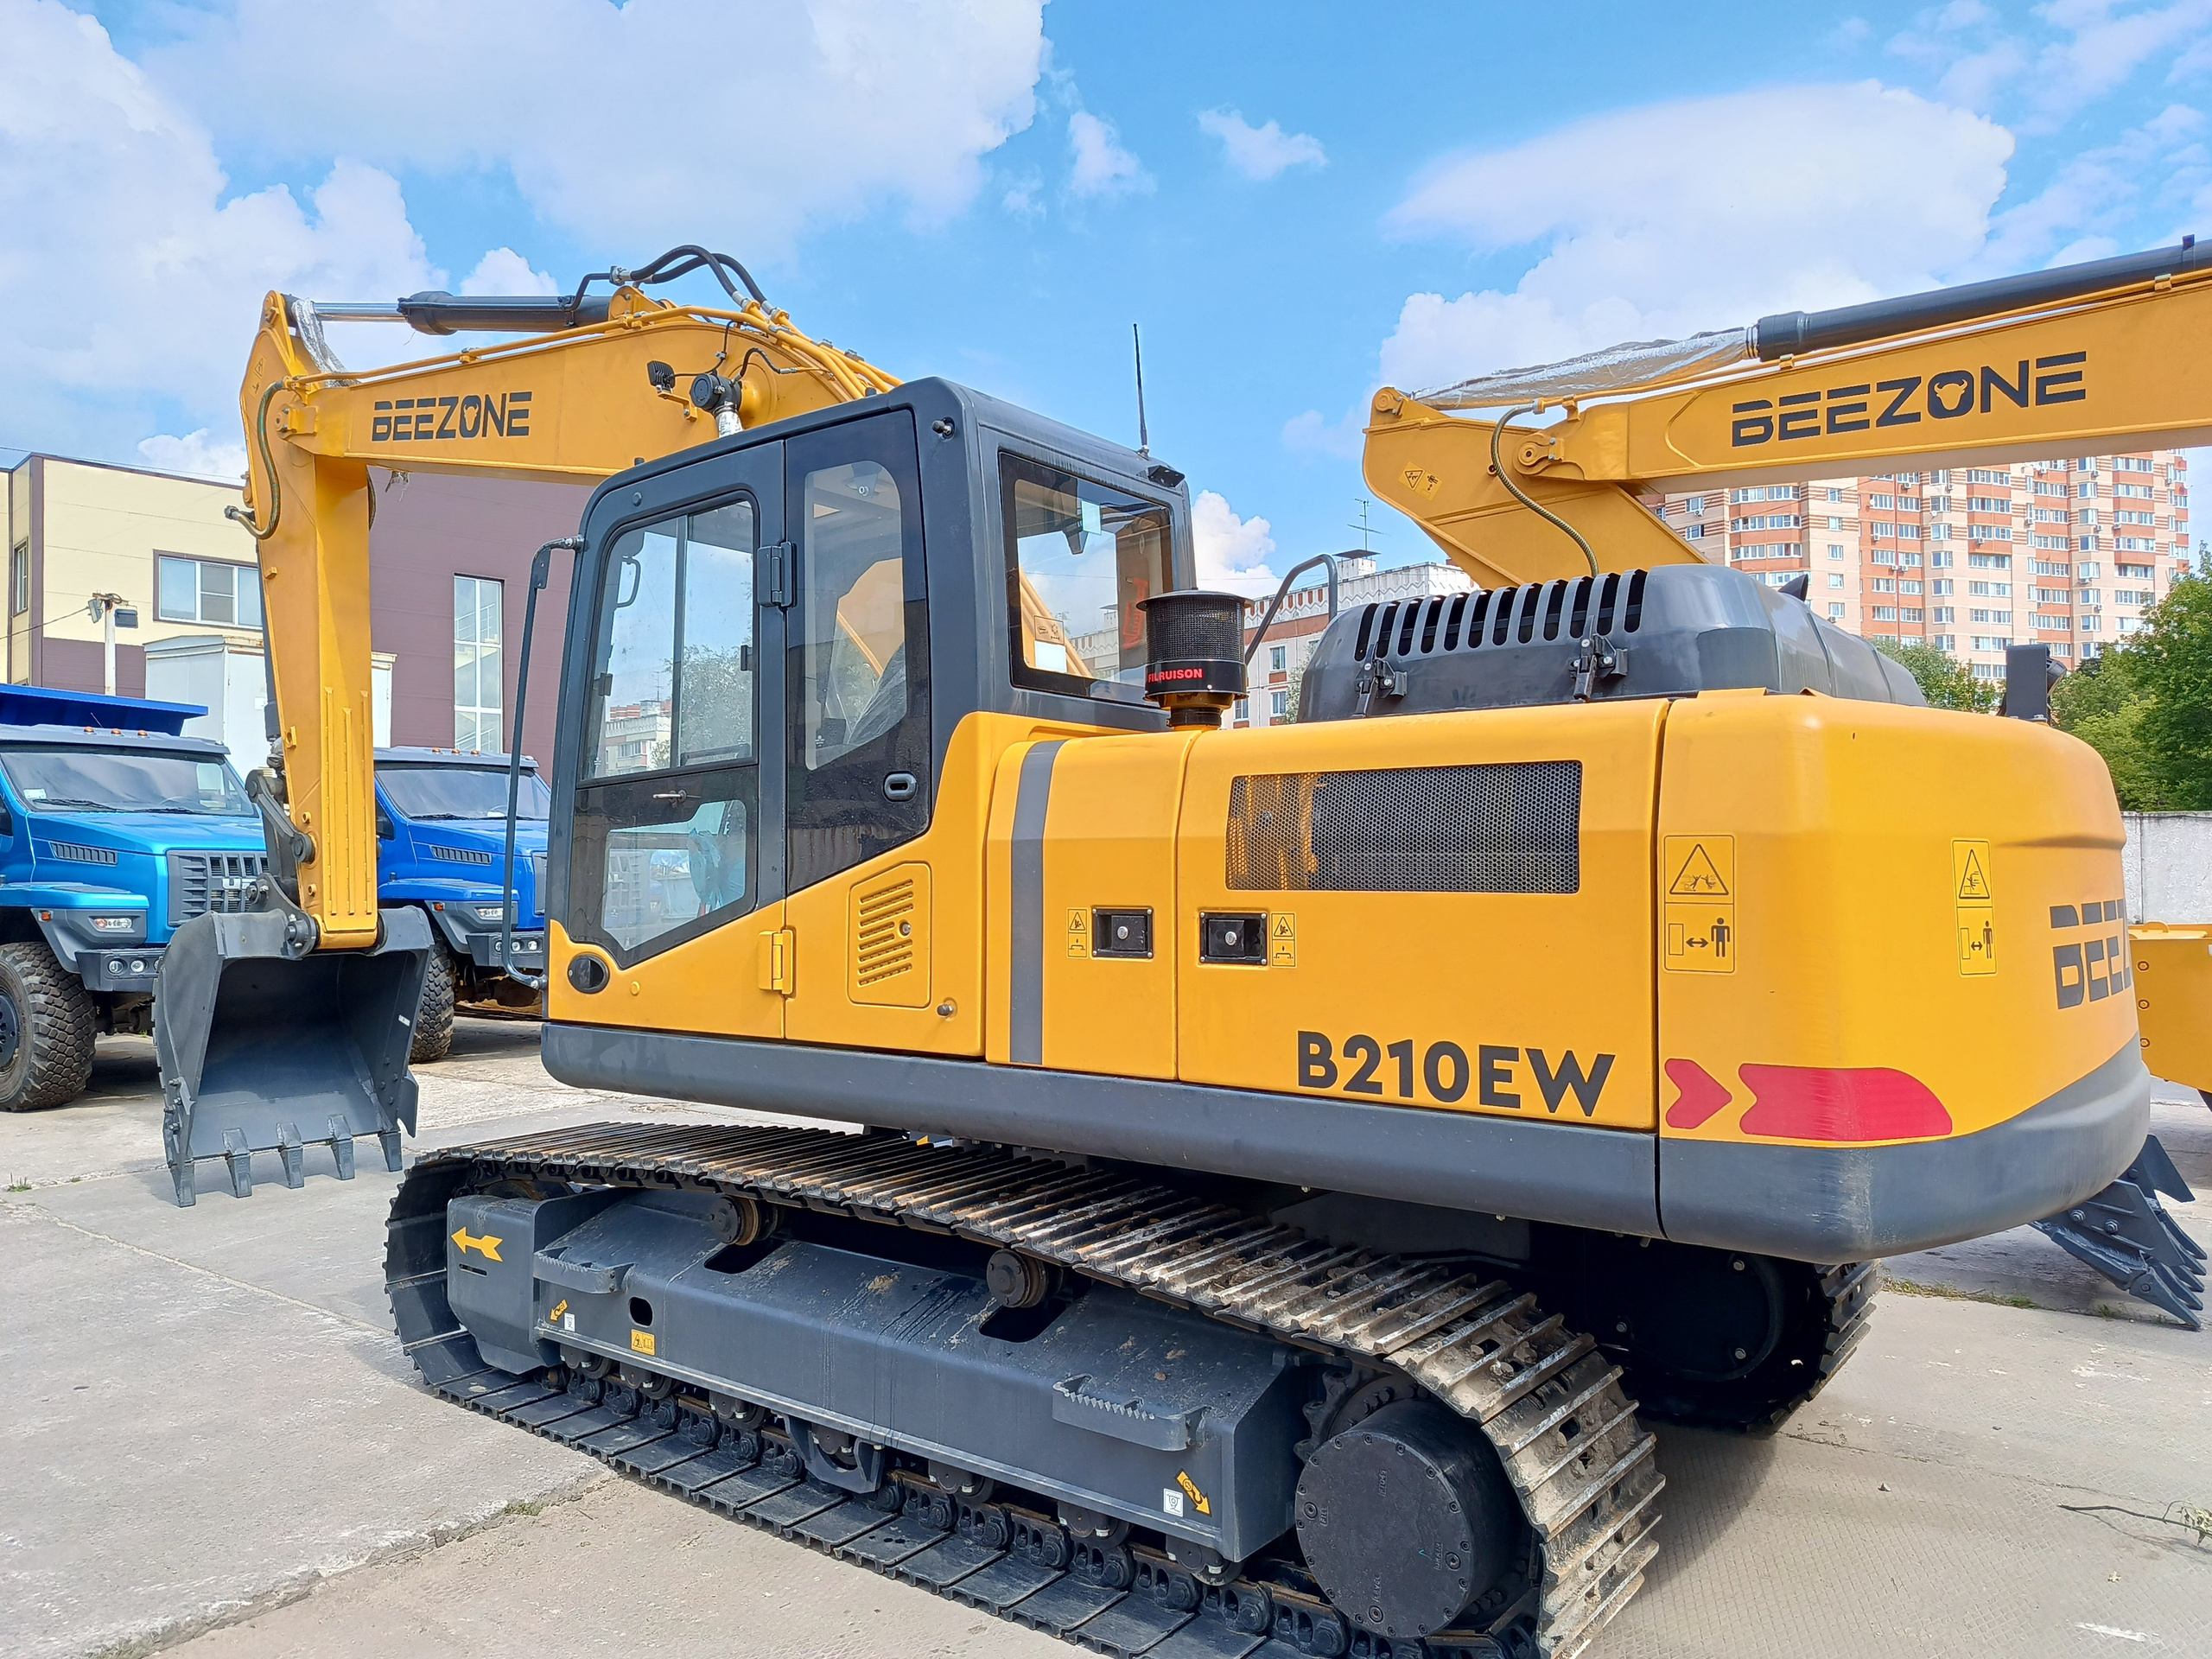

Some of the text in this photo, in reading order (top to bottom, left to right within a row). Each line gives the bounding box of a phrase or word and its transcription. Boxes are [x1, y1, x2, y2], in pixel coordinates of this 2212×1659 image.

[373, 391, 532, 442] BEEZONE
[1732, 350, 2086, 448] BEEZONE
[1298, 1031, 1616, 1116] B210EW
